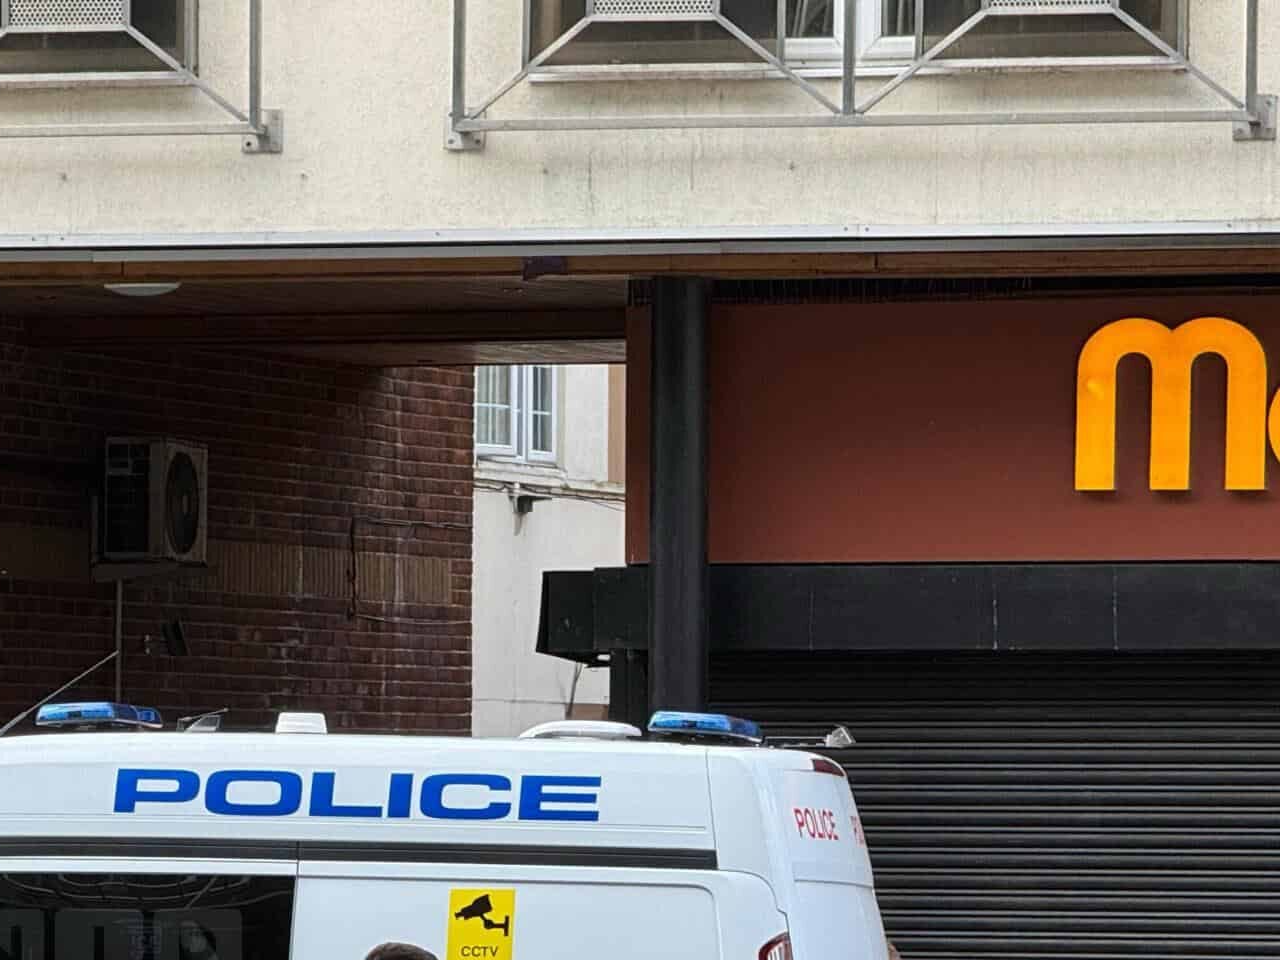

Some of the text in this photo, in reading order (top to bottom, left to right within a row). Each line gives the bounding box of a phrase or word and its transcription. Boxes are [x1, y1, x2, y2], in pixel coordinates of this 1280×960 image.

[112, 767, 602, 822] POLICE
[793, 807, 839, 841] POLICE
[461, 945, 499, 958] CCTV
